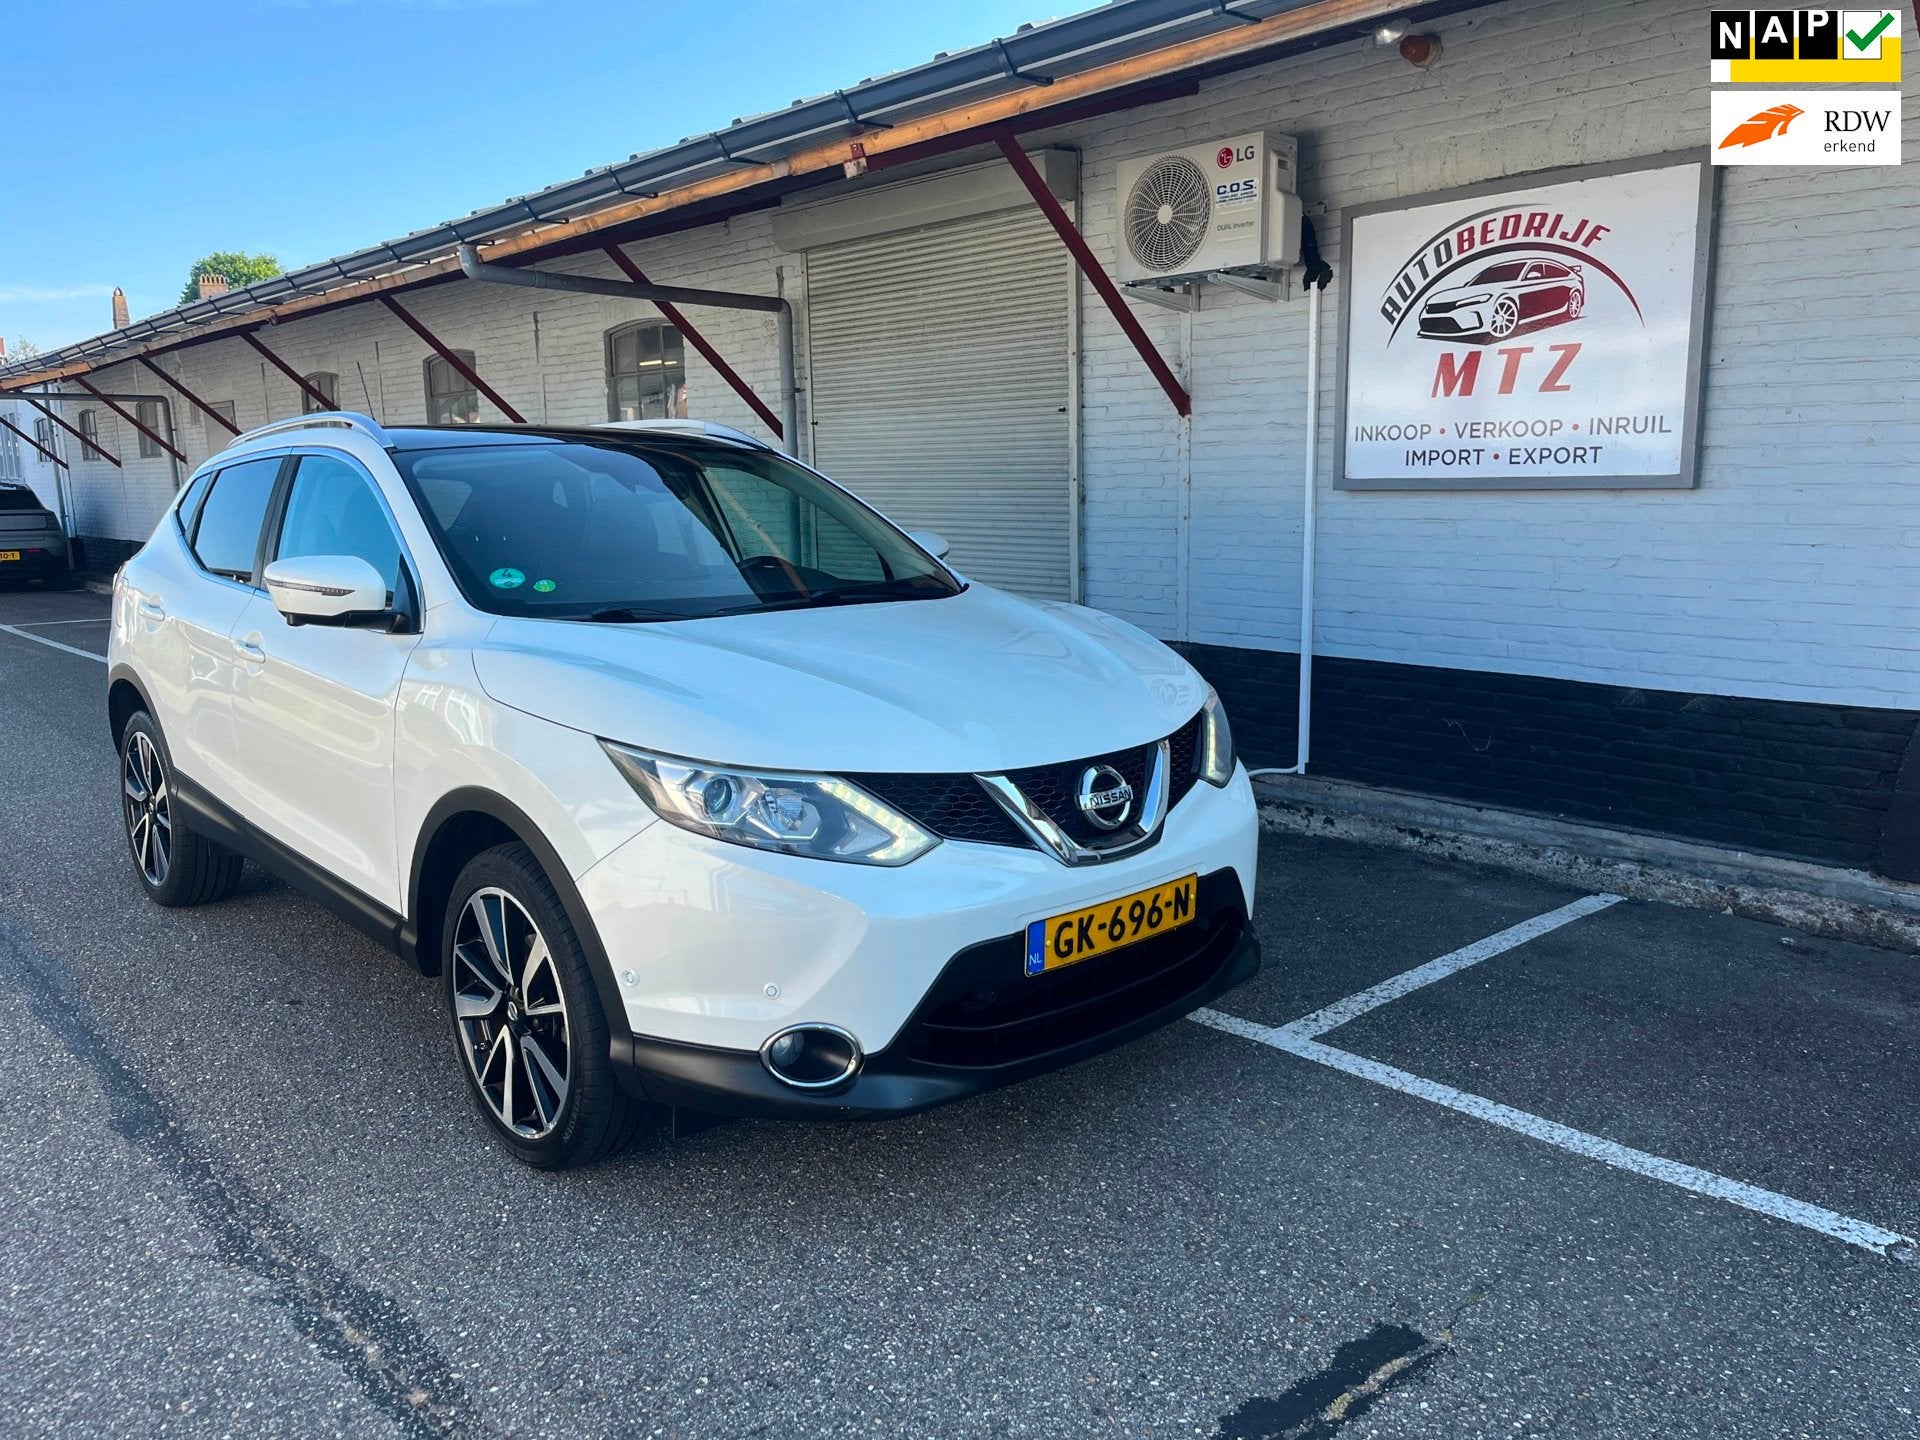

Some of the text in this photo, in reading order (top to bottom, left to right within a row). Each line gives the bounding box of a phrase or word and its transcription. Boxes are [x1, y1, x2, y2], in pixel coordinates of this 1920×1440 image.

[1236, 145, 1255, 163] LG
[1216, 179, 1257, 196] C.O.S.
[1217, 223, 1232, 231] DUAL
[1380, 212, 1611, 325] AUTOBEDRIJF
[1431, 343, 1582, 398] MTZ
[1354, 415, 1672, 442] INKOOP VERKOOP INRUIL
[1405, 446, 1603, 466] IMPORT EXPORT
[1090, 789, 1131, 806] NISSAN
[1053, 883, 1190, 958] GK-696-N
[1029, 952, 1042, 966] NL
